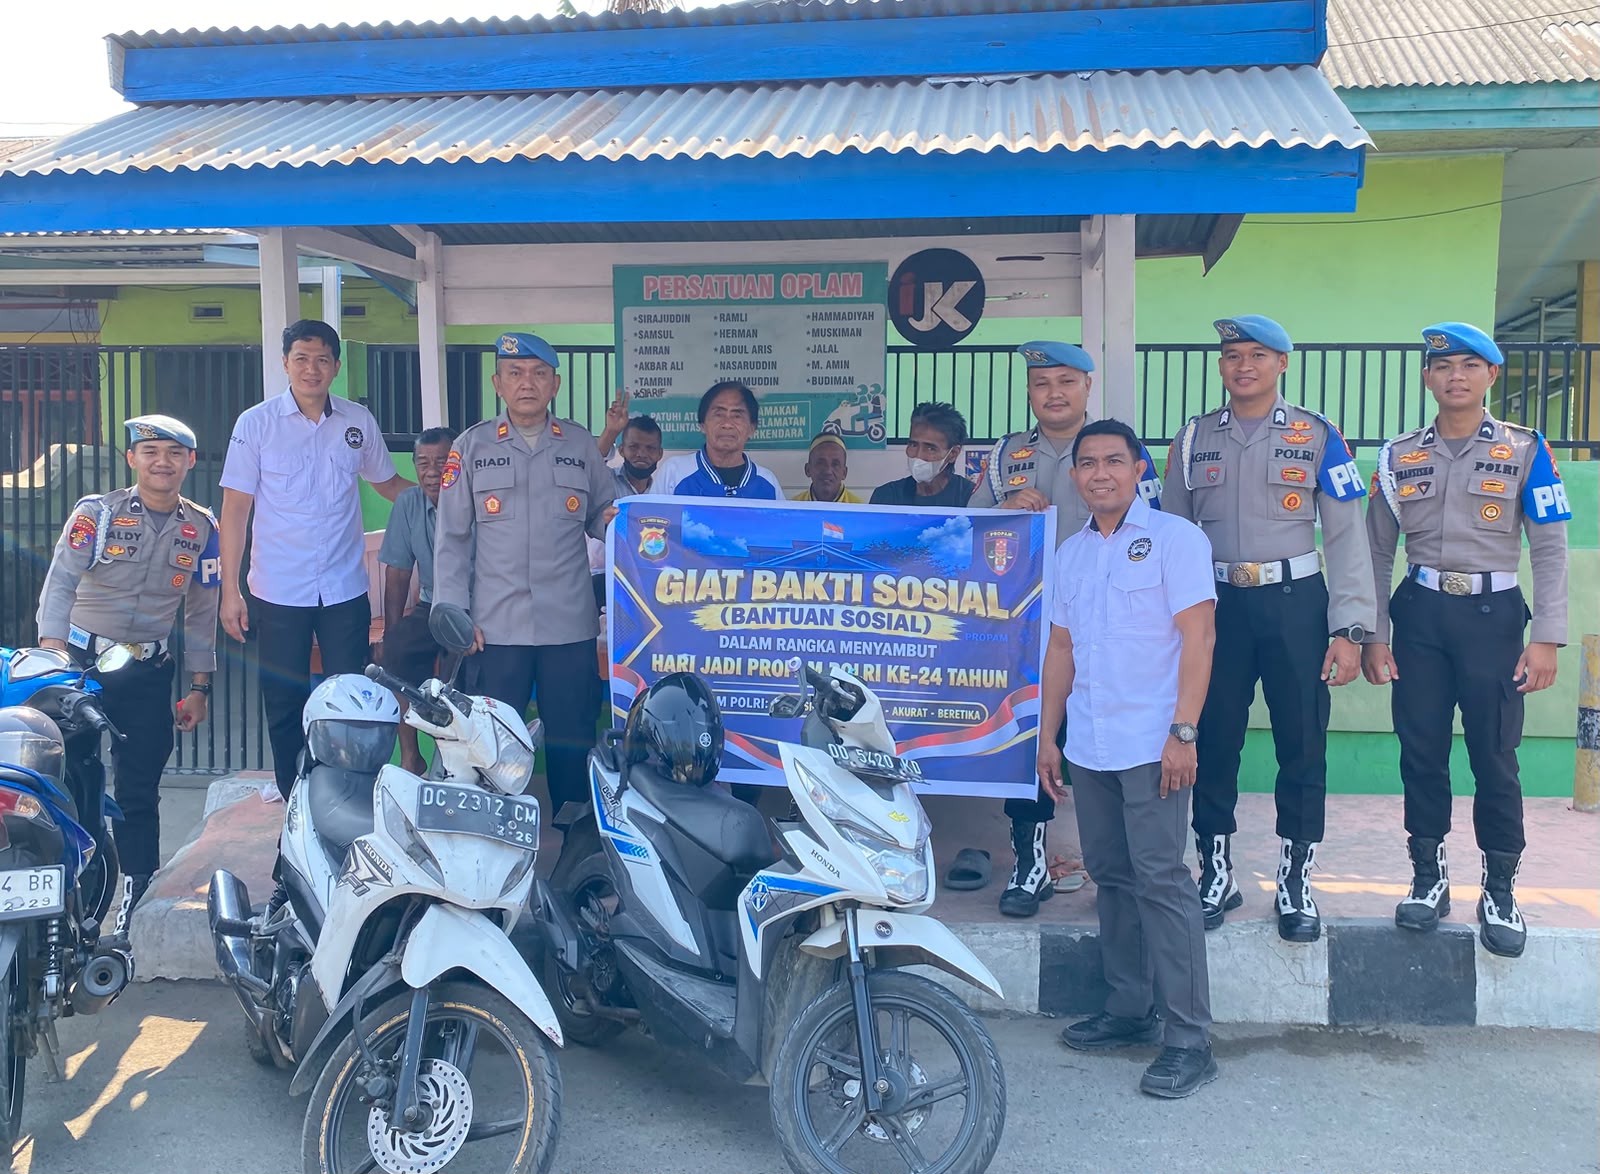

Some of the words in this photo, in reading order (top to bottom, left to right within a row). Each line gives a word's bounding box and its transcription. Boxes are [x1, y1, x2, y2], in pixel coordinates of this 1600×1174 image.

[643, 274, 774, 301] PERSATUAN
[780, 272, 863, 299] OPLAM
[638, 313, 691, 324] SIRAJUDDIN
[719, 312, 748, 323] RAMLI
[811, 311, 875, 321] HAMMADIYAH
[638, 329, 675, 340] SAMSUL
[719, 328, 758, 339] HERMAN
[811, 327, 862, 338] MUSKIMAN
[638, 345, 671, 355] AMRAN
[719, 344, 749, 355] ABDUL
[751, 344, 773, 354] ARIS
[811, 343, 840, 354] JALAL
[638, 361, 668, 371] AKBAR
[670, 361, 684, 371] ALI
[719, 360, 777, 371] NASARUDDIN
[811, 360, 823, 370] M.
[825, 359, 850, 370] AMIN
[639, 376, 673, 387] TAMRIN
[811, 375, 855, 386] BUDIMAN
[758, 405, 798, 416] AMAKAN
[656, 422, 702, 432] LULINTAS
[757, 416, 806, 428] ELAMATAN
[751, 428, 804, 440] RKENDARA
[1275, 448, 1314, 462] POLRI
[474, 456, 511, 470] RIADI
[1474, 461, 1520, 477] POLRI
[655, 566, 745, 604] GIAT
[750, 568, 864, 603] BAKTI
[872, 573, 1010, 620] SOSIAL
[720, 606, 835, 627] (BANTUAN
[840, 610, 932, 634] SOSIAL)
[965, 632, 1009, 643] PROPAM
[719, 635, 772, 651] DALAM
[776, 637, 836, 654] RANGKA
[840, 640, 938, 659] MENYAMBUT
[652, 653, 696, 674] HARI
[700, 655, 742, 677] JADI
[886, 664, 943, 686] KE-24
[947, 667, 1008, 689] TAHUN
[730, 696, 769, 709] POLRI:
[892, 707, 929, 718] AKURAT
[937, 708, 981, 720] BERETIKA
[856, 749, 894, 769] 5420
[423, 787, 447, 807] DC
[458, 792, 504, 817] 2312
[514, 804, 537, 825] CM
[363, 842, 393, 878] HONDA
[811, 849, 842, 880] HONDA
[29, 874, 53, 891] BR
